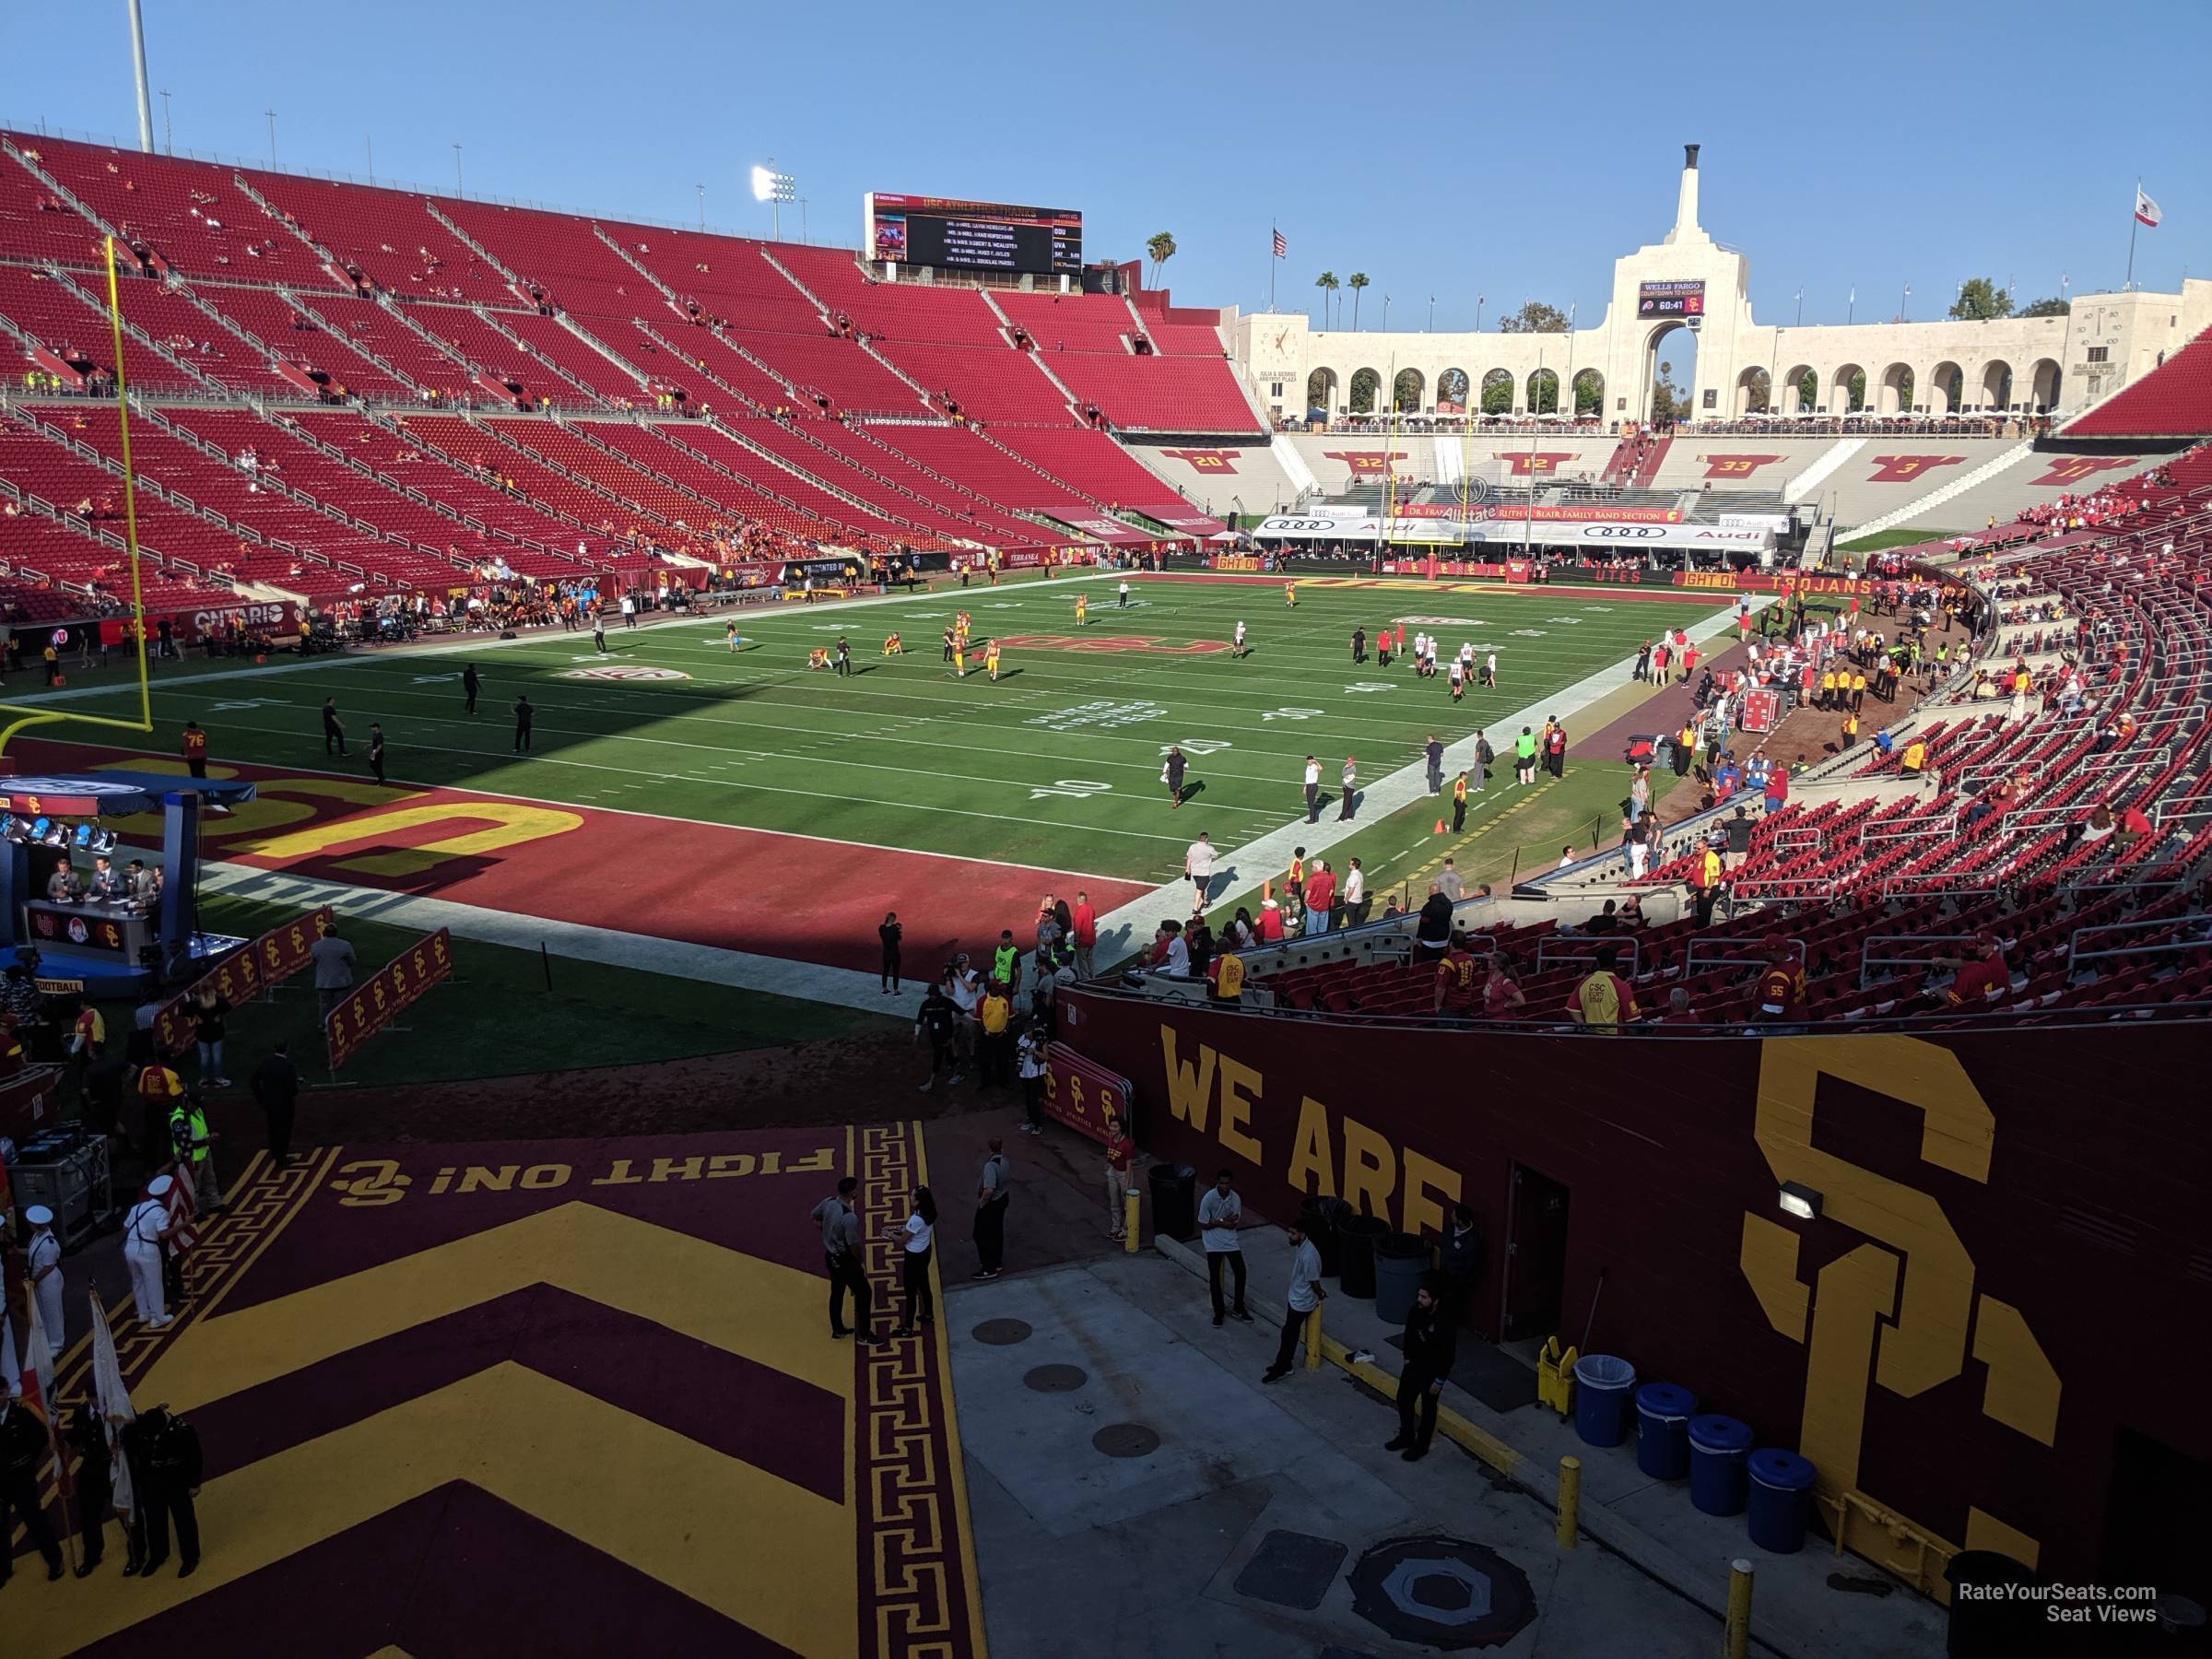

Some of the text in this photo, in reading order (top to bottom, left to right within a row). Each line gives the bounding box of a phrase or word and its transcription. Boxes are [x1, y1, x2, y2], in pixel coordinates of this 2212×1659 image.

[1659, 300, 1683, 310] 60:41
[1688, 317, 1700, 326] 25
[1194, 456, 1224, 466] 20
[1356, 457, 1384, 468] 32
[1523, 457, 1548, 469] 12
[1719, 461, 1750, 471] 33
[1896, 463, 1920, 475] 3
[1444, 506, 1497, 524] Allstate
[1499, 509, 1522, 517] RUTH
[1536, 510, 1560, 518] BLAIR
[1562, 510, 1593, 520] FAMILY
[1622, 512, 1660, 521] SECTION
[1360, 523, 1416, 531] Audi
[1696, 531, 1760, 540] Audi
[1010, 552, 1039, 561] TERRANEA
[1595, 568, 1641, 583] UTES
[1771, 576, 1871, 594] TROJANS
[194, 604, 284, 630] ONTARIO
[1021, 701, 1115, 724] UNITED
[1048, 701, 1156, 731] AIRLINES
[1099, 709, 1169, 728] FIELD
[188, 734, 205, 747] 76
[36, 981, 81, 993] FOOTBALL
[1588, 982, 1606, 992] CSC
[1771, 984, 1784, 996] 55
[1070, 1075, 1086, 1115] SC
[1160, 1023, 1263, 1167] WE
[591, 1147, 837, 1187] FIGHT
[1288, 1095, 1463, 1235] ARE
[429, 1163, 573, 1195] ON!
